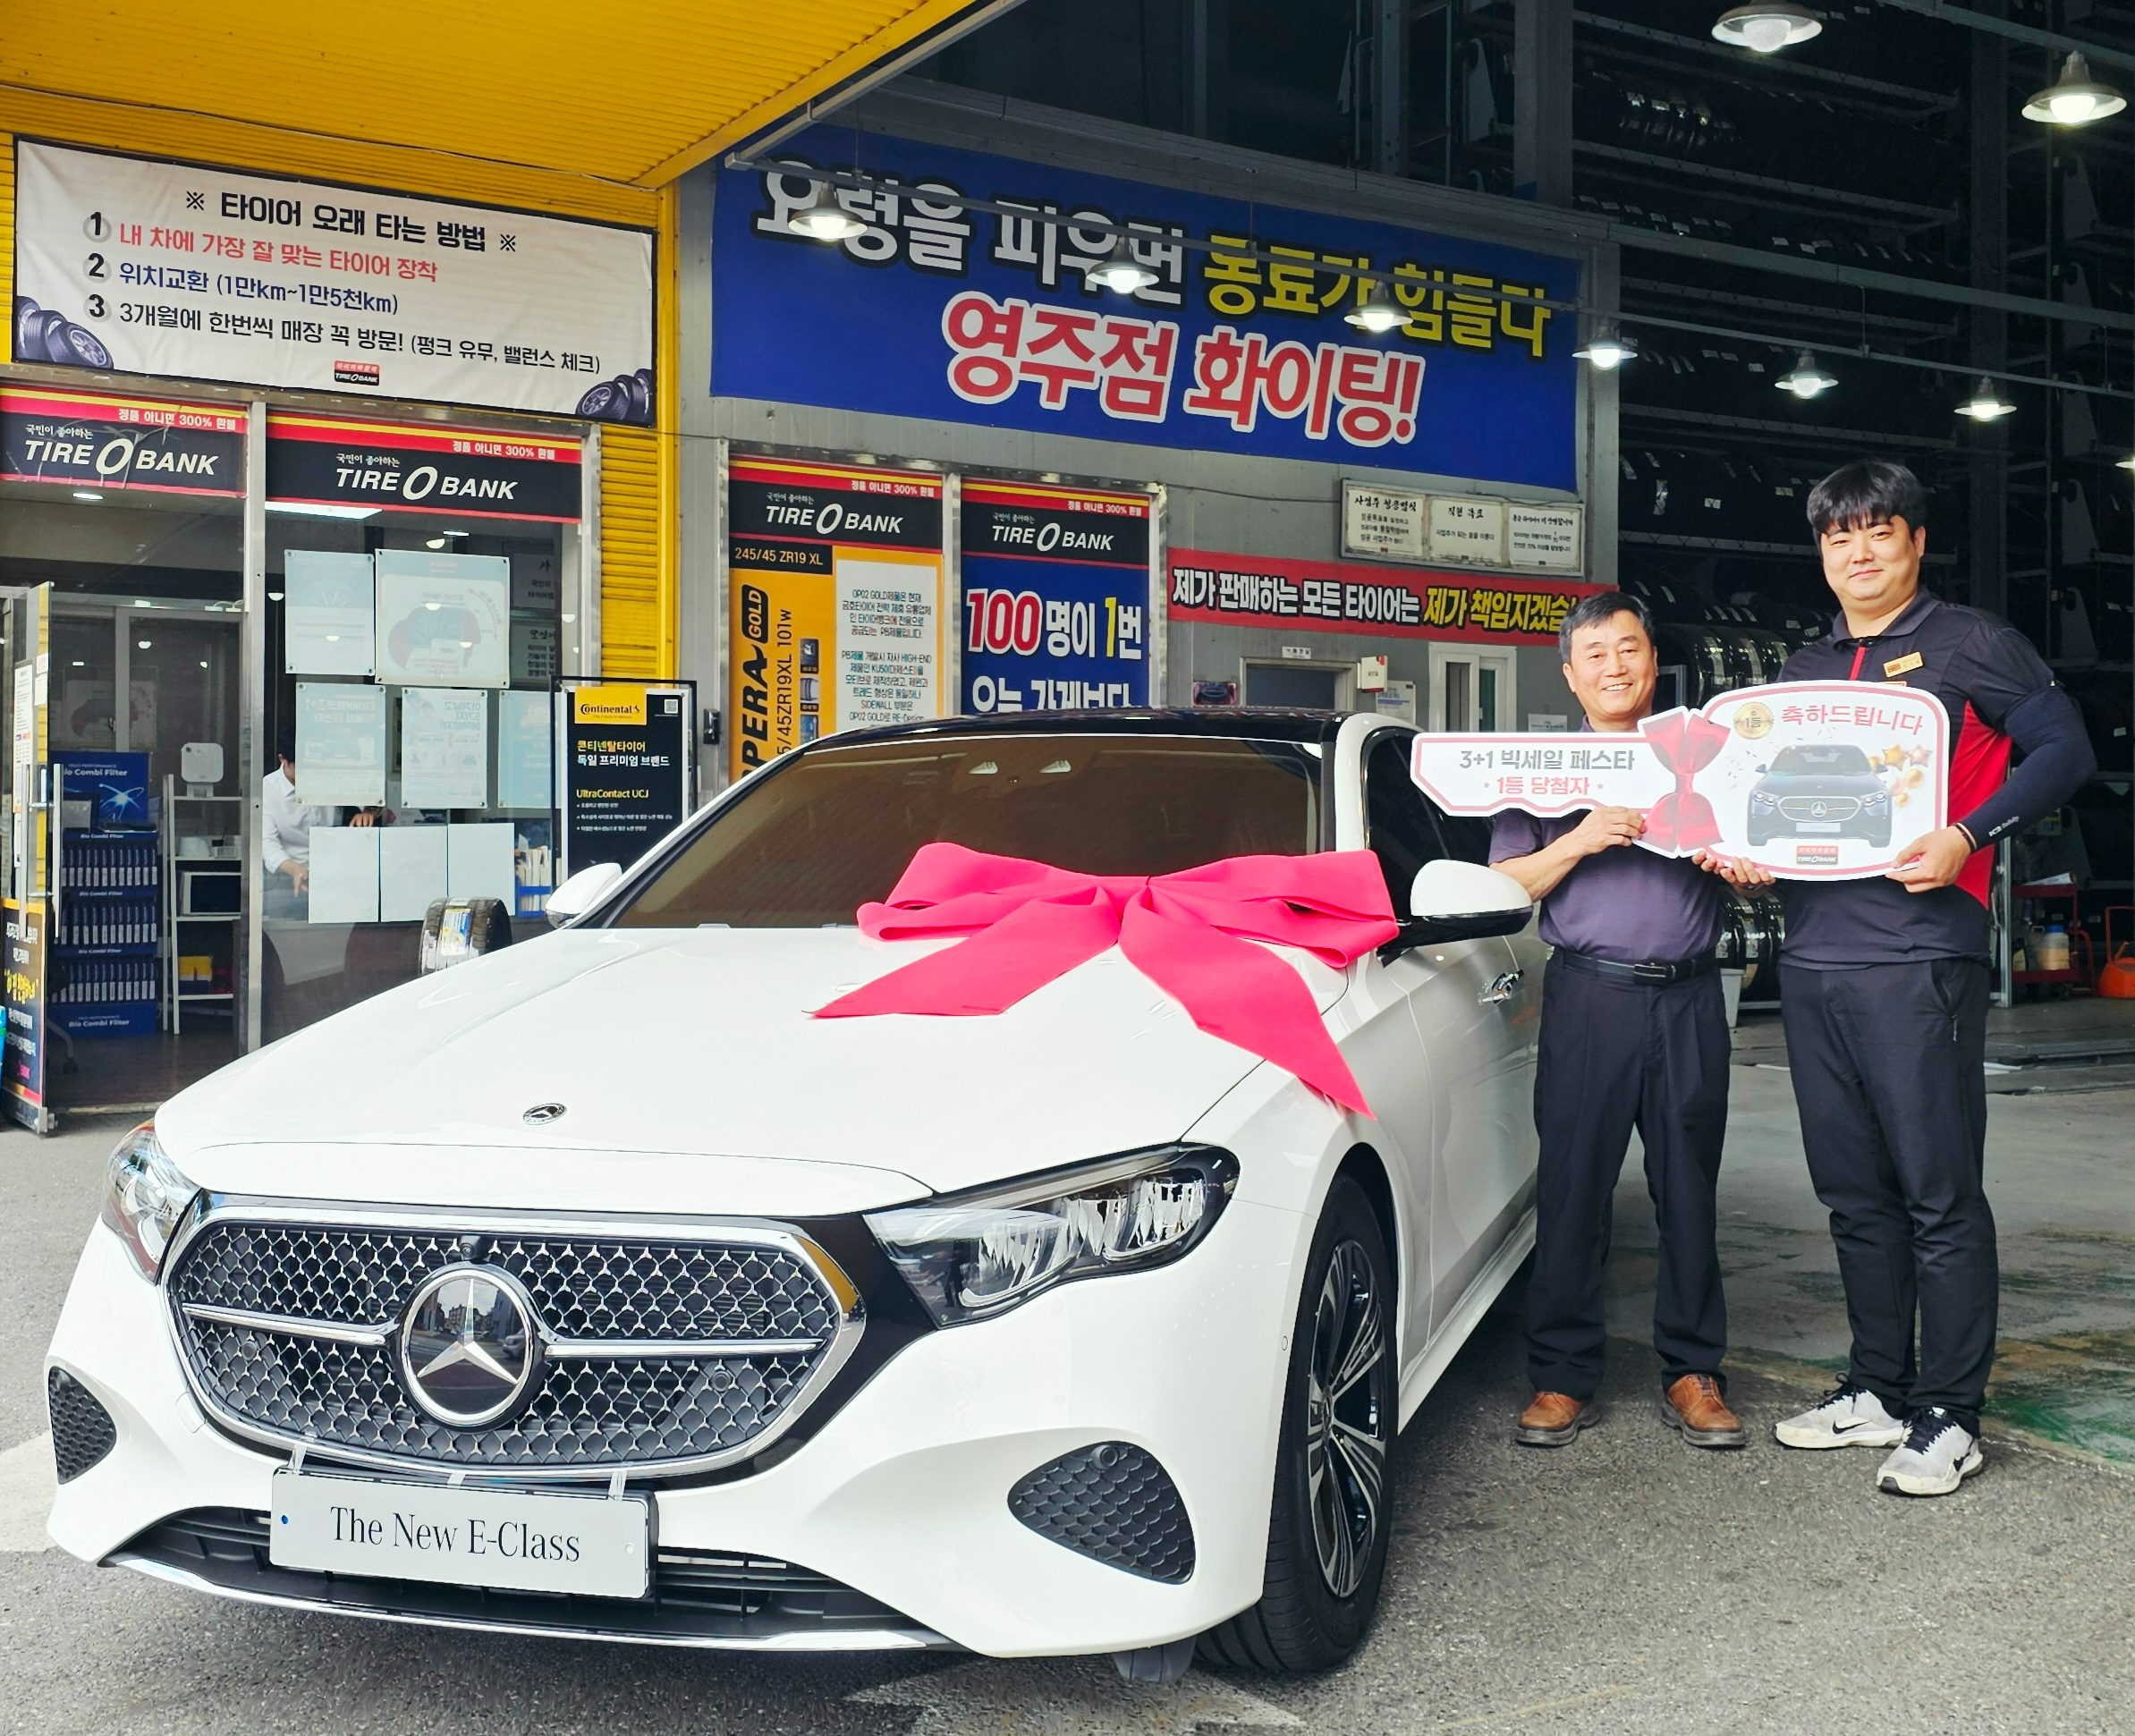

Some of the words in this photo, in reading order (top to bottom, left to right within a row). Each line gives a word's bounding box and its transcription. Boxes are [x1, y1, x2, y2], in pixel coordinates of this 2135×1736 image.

[220, 191, 301, 226] 타이어
[313, 204, 365, 235] 오래
[376, 213, 427, 243] 타는
[436, 221, 486, 252] 방법
[757, 161, 970, 271] 요령을
[994, 199, 1183, 305] 피우면
[120, 223, 142, 247] 내
[149, 227, 194, 253] 차에
[202, 233, 246, 259] 가장
[252, 240, 274, 263] 잘
[281, 244, 322, 267] 맞는
[329, 249, 390, 277] 타이어
[397, 258, 438, 283] 장착
[119, 262, 209, 293] 위치교환
[120, 302, 201, 331] 3개월에
[208, 311, 274, 339] 한번씩
[282, 320, 324, 344] 매장
[330, 325, 351, 347] 꼭
[358, 327, 403, 351] 방문!
[411, 334, 453, 357] (펑크
[459, 340, 498, 363] 유무,
[504, 345, 555, 368] 밸런스
[561, 351, 600, 375] 체크)
[942, 291, 1180, 426] 영주점
[1183, 326, 1427, 448] 화이팅!
[144, 411, 174, 425] 아니면
[179, 415, 212, 428] 300%
[25, 424, 54, 436] 국민이
[453, 440, 470, 453] 정품
[475, 443, 502, 455] 아니면
[505, 445, 534, 458] 300%
[335, 453, 362, 464] 국민이
[365, 455, 400, 467] 좋아하는
[869, 481, 891, 494] 아니면
[894, 483, 918, 495] 300%
[767, 492, 786, 503] 국민이
[788, 494, 814, 504] 좋아하는
[993, 512, 1011, 522] 국민이
[1083, 502, 1103, 513] 아니면
[1106, 504, 1127, 514] 300%
[734, 547, 776, 562] 245/45
[780, 550, 806, 564] ZR19
[809, 553, 823, 565] XL
[843, 600, 875, 612] 금호타이어
[1173, 568, 1216, 607] 제가
[1219, 572, 1299, 614] 판매하는
[1302, 580, 1342, 617] 모든
[1345, 584, 1419, 623] 타이어는
[1423, 588, 1468, 626] 제가
[1470, 590, 1579, 632] 책임지겠습
[749, 589, 762, 639] GOLD
[966, 588, 1096, 658] 100명이
[1104, 597, 1142, 660] 1번
[580, 703, 632, 715] Continental
[741, 644, 768, 778] PERA
[777, 654, 792, 755] 5/45ZR19XL
[861, 699, 892, 710] SIDEWALL
[1781, 704, 1923, 735] 축하드립니다
[577, 740, 646, 753] 콘티넨탈타이어
[577, 754, 597, 767] 독일
[598, 755, 639, 767] 프리미엄
[640, 755, 670, 767] 브랜드
[1459, 749, 1494, 769] 3+1
[1501, 749, 1563, 770] 빅세일
[1569, 749, 1635, 770] 페스타
[64, 768, 72, 776] io
[74, 768, 103, 776] Combi
[105, 768, 128, 776] Filter
[576, 789, 631, 799] UltraContact
[631, 789, 648, 799] UCJ
[1496, 776, 1524, 794] 1등
[1530, 776, 1590, 796] 당첨자
[83, 1020, 107, 1028] Combi
[329, 1505, 383, 1545] The
[394, 1512, 458, 1553] New
[468, 1519, 580, 1562] E-Class
